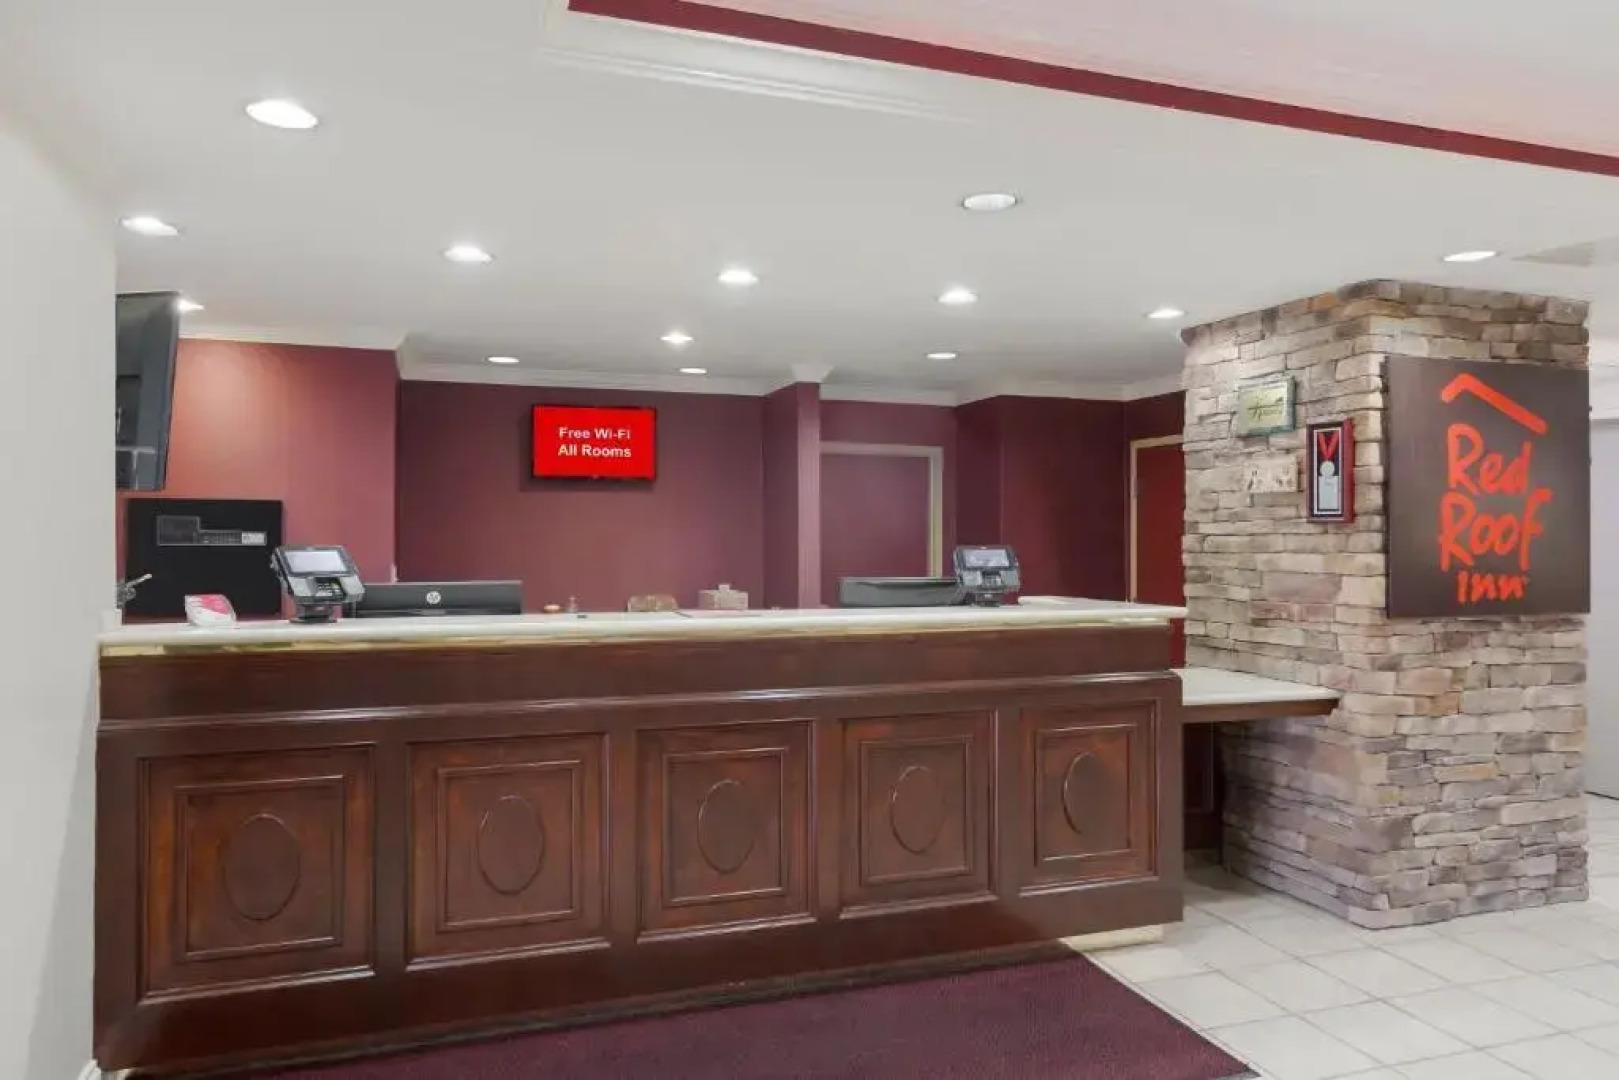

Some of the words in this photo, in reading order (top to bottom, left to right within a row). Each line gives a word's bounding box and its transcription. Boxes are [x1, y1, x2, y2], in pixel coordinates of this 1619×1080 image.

[557, 443, 578, 456] All
[581, 444, 632, 458] Rooms
[558, 426, 591, 439] Free
[594, 427, 631, 440] Wi-Fi
[1447, 423, 1533, 495] Red
[1438, 488, 1553, 572] Roof
